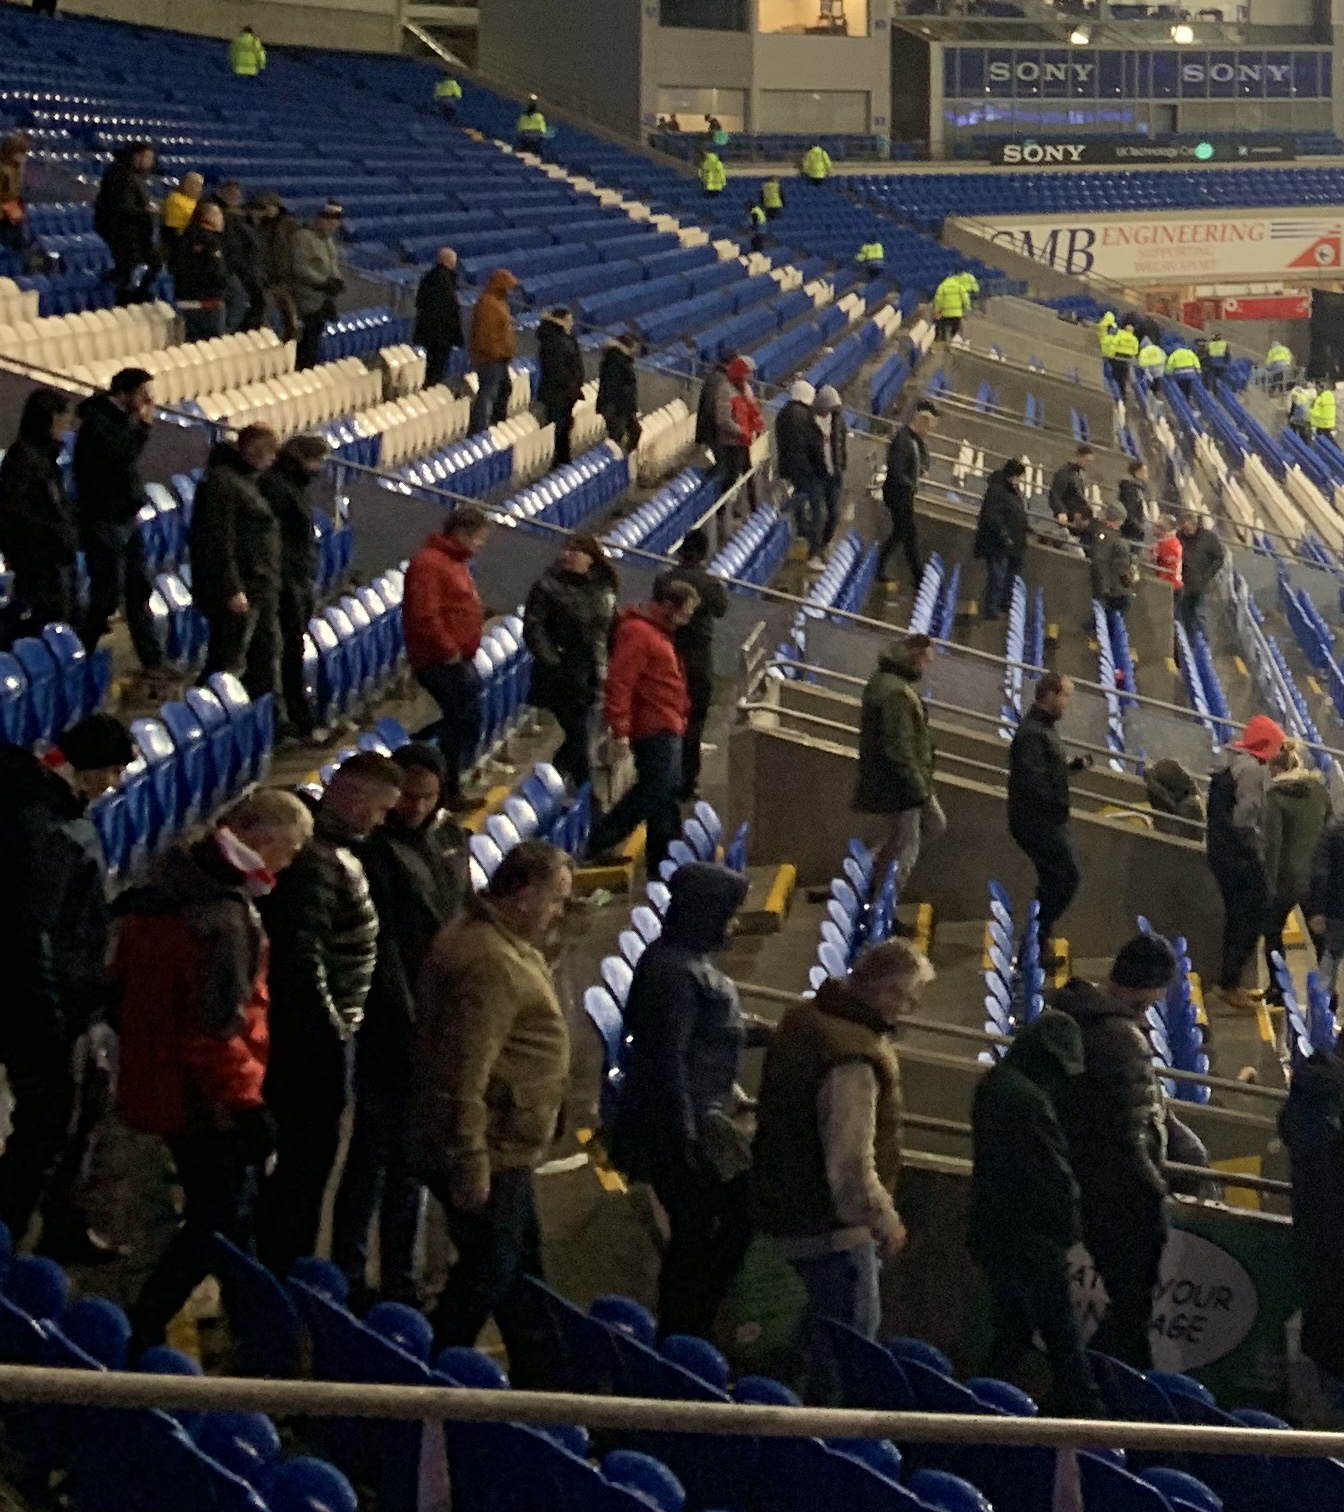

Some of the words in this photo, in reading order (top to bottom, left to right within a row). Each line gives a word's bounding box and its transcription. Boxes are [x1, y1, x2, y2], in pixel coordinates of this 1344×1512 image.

[989, 61, 1095, 82] SONY
[1182, 64, 1291, 83] SONY
[1003, 144, 1085, 163] SONY
[1101, 220, 1265, 246] ENGINEERING
